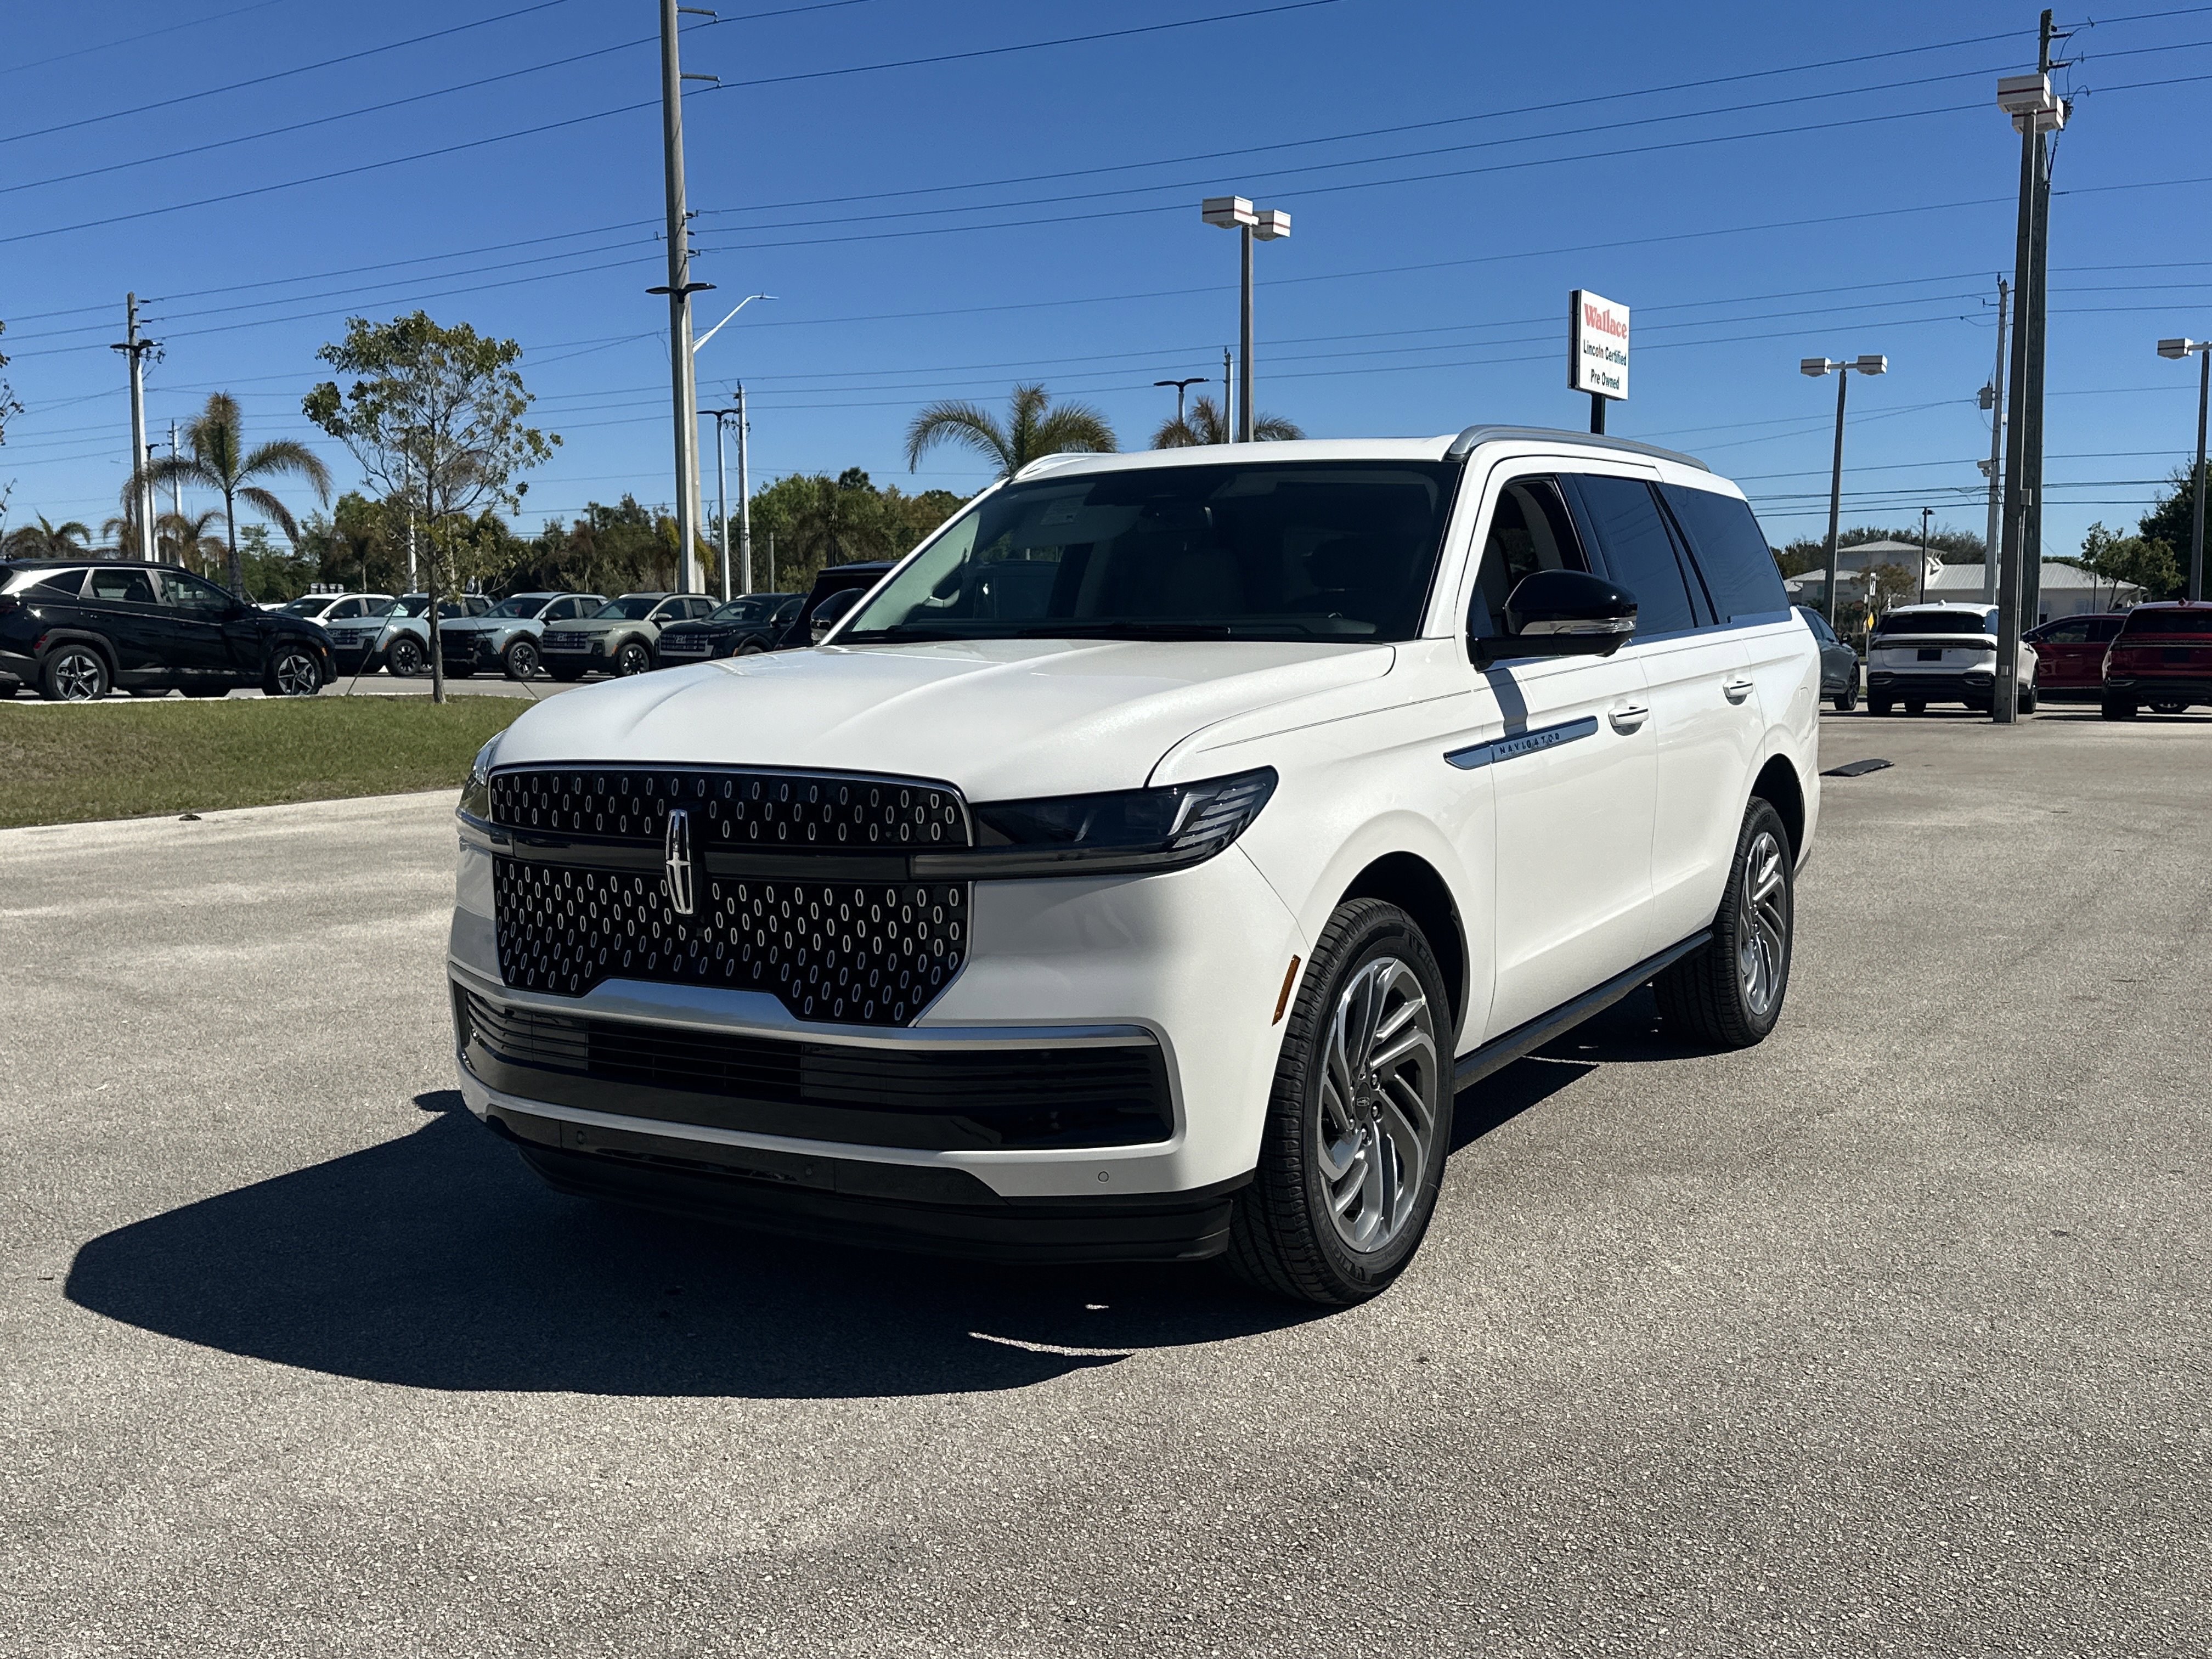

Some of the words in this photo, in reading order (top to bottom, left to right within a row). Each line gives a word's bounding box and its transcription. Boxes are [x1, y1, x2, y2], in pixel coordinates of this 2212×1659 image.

[1584, 303, 1627, 339] Wallace
[1583, 338, 1604, 359] Lincoln
[1605, 346, 1627, 366] Certified
[1590, 368, 1600, 385] Pre
[1601, 372, 1620, 390] Owned
[1499, 732, 1560, 755] NAVIGATOR
